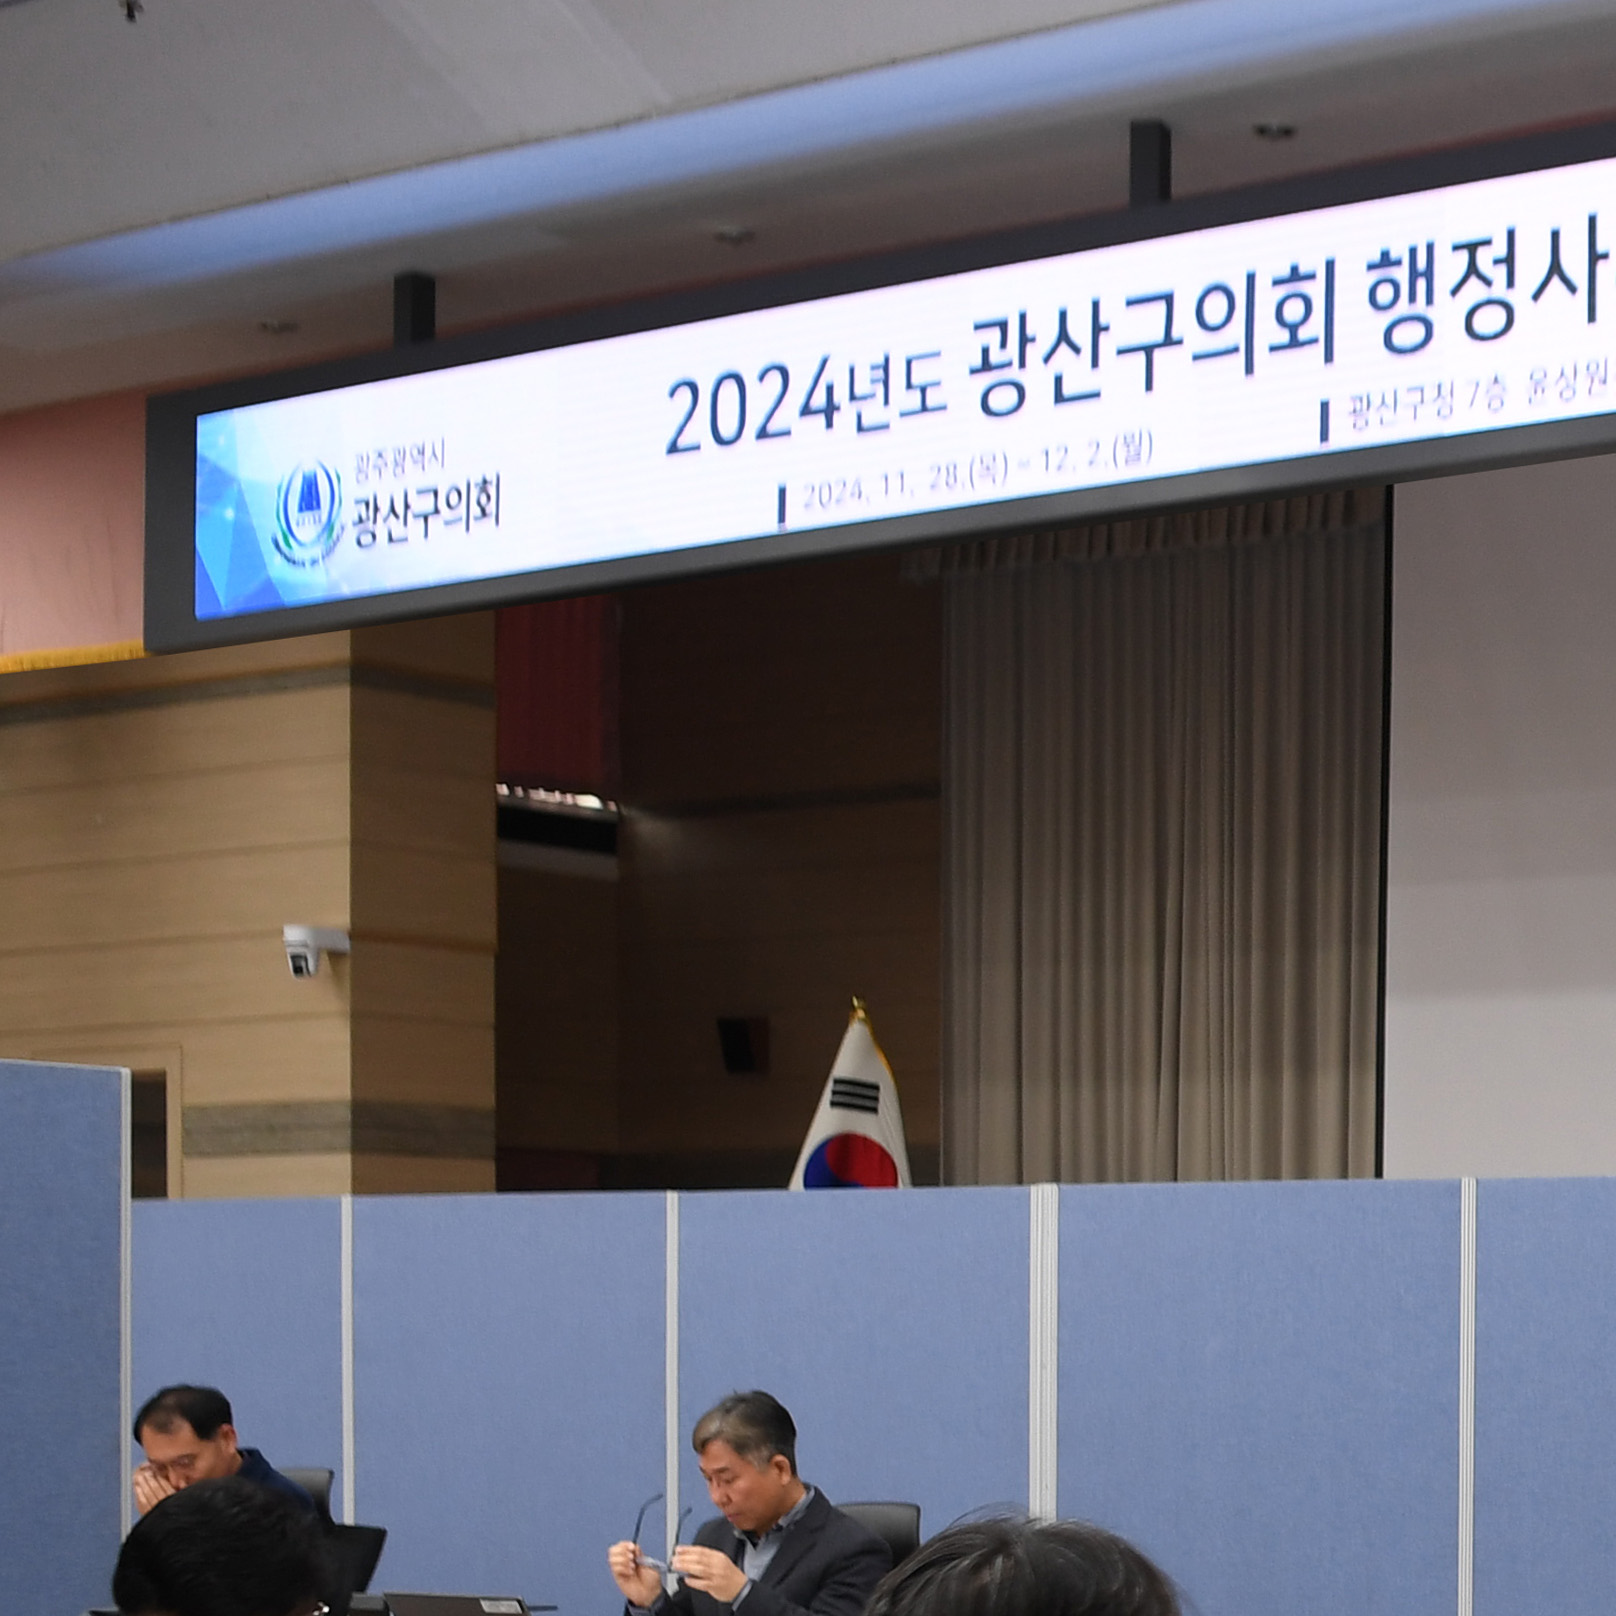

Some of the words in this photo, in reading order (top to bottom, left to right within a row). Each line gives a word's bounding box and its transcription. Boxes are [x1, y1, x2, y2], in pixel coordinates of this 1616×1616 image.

[666, 350, 949, 456] 2024년도
[967, 254, 1338, 419] 광산구의회
[351, 470, 501, 549] 광산구의회
